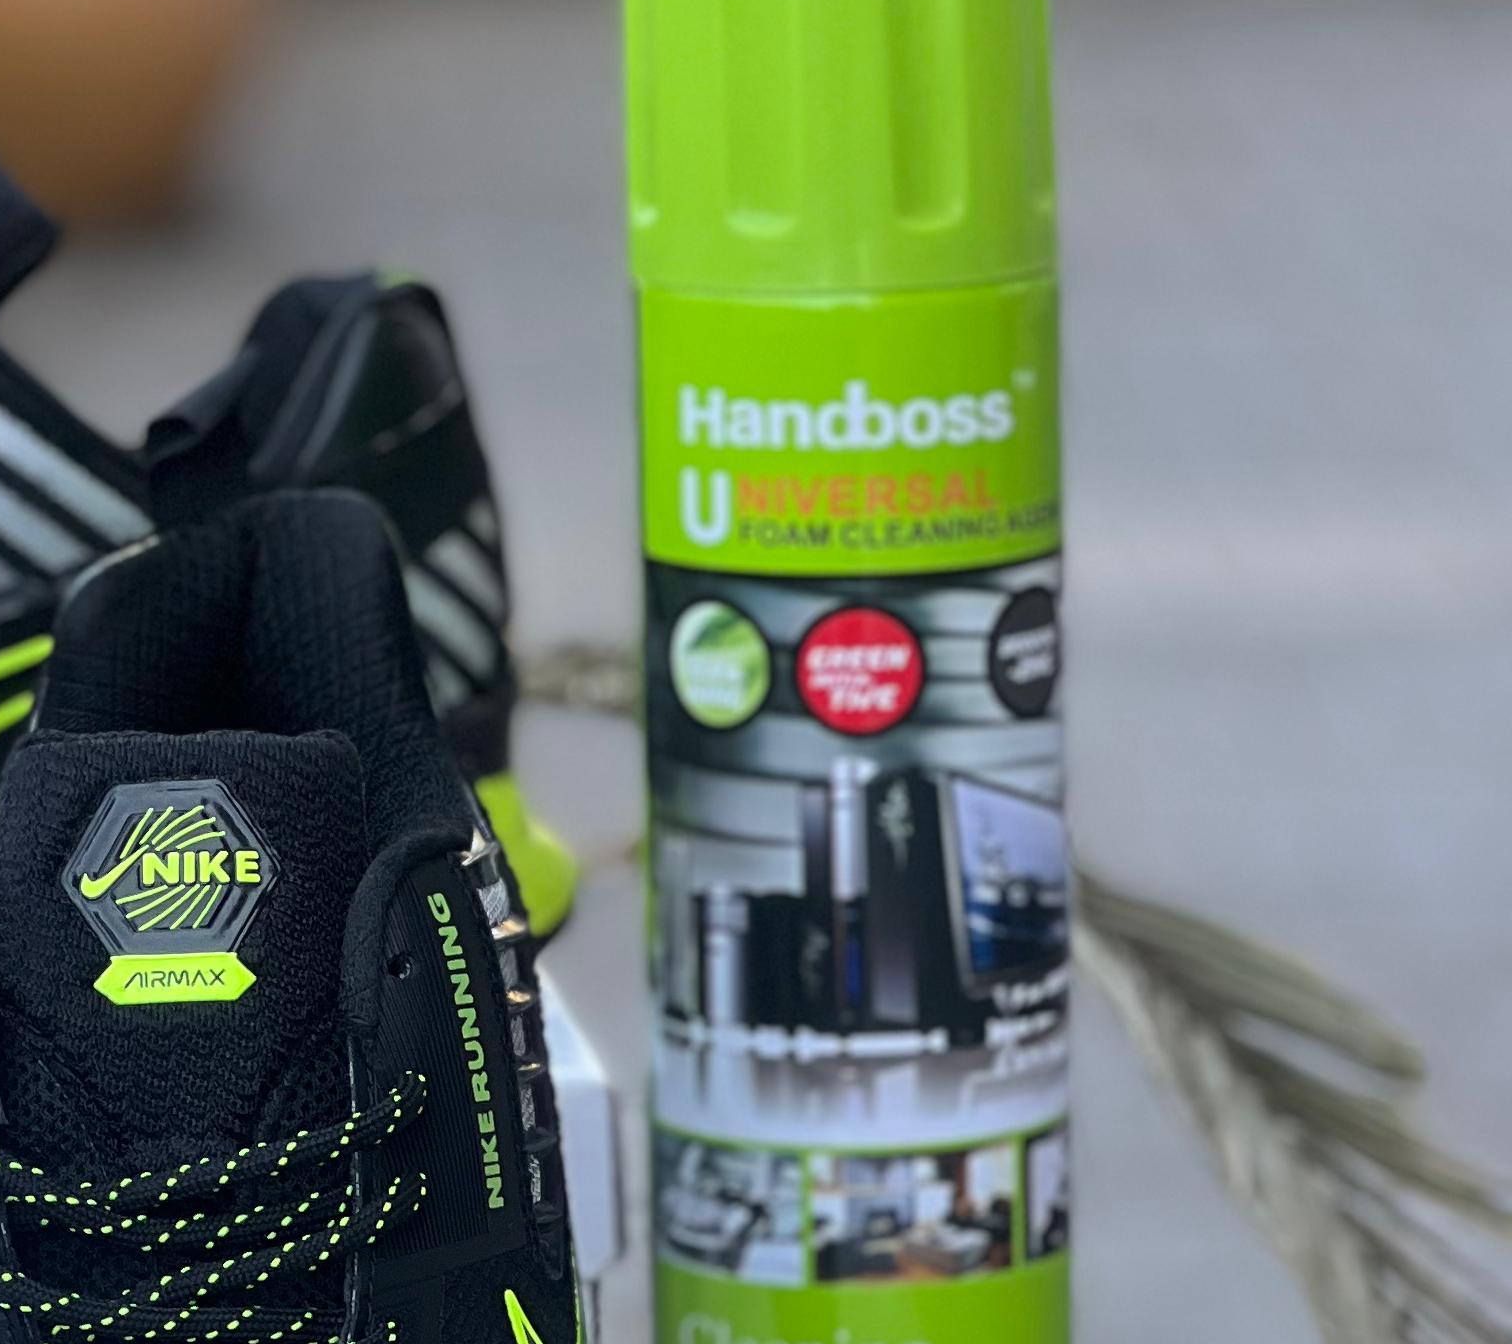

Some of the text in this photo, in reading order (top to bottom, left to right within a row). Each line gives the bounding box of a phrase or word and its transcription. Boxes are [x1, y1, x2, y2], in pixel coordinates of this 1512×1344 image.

[678, 379, 1013, 450] Handboss
[739, 519, 830, 549] FOAM
[141, 850, 261, 885] NIKE
[123, 968, 226, 990] AIRMAX
[427, 892, 505, 1209] NIKE RUNNING
